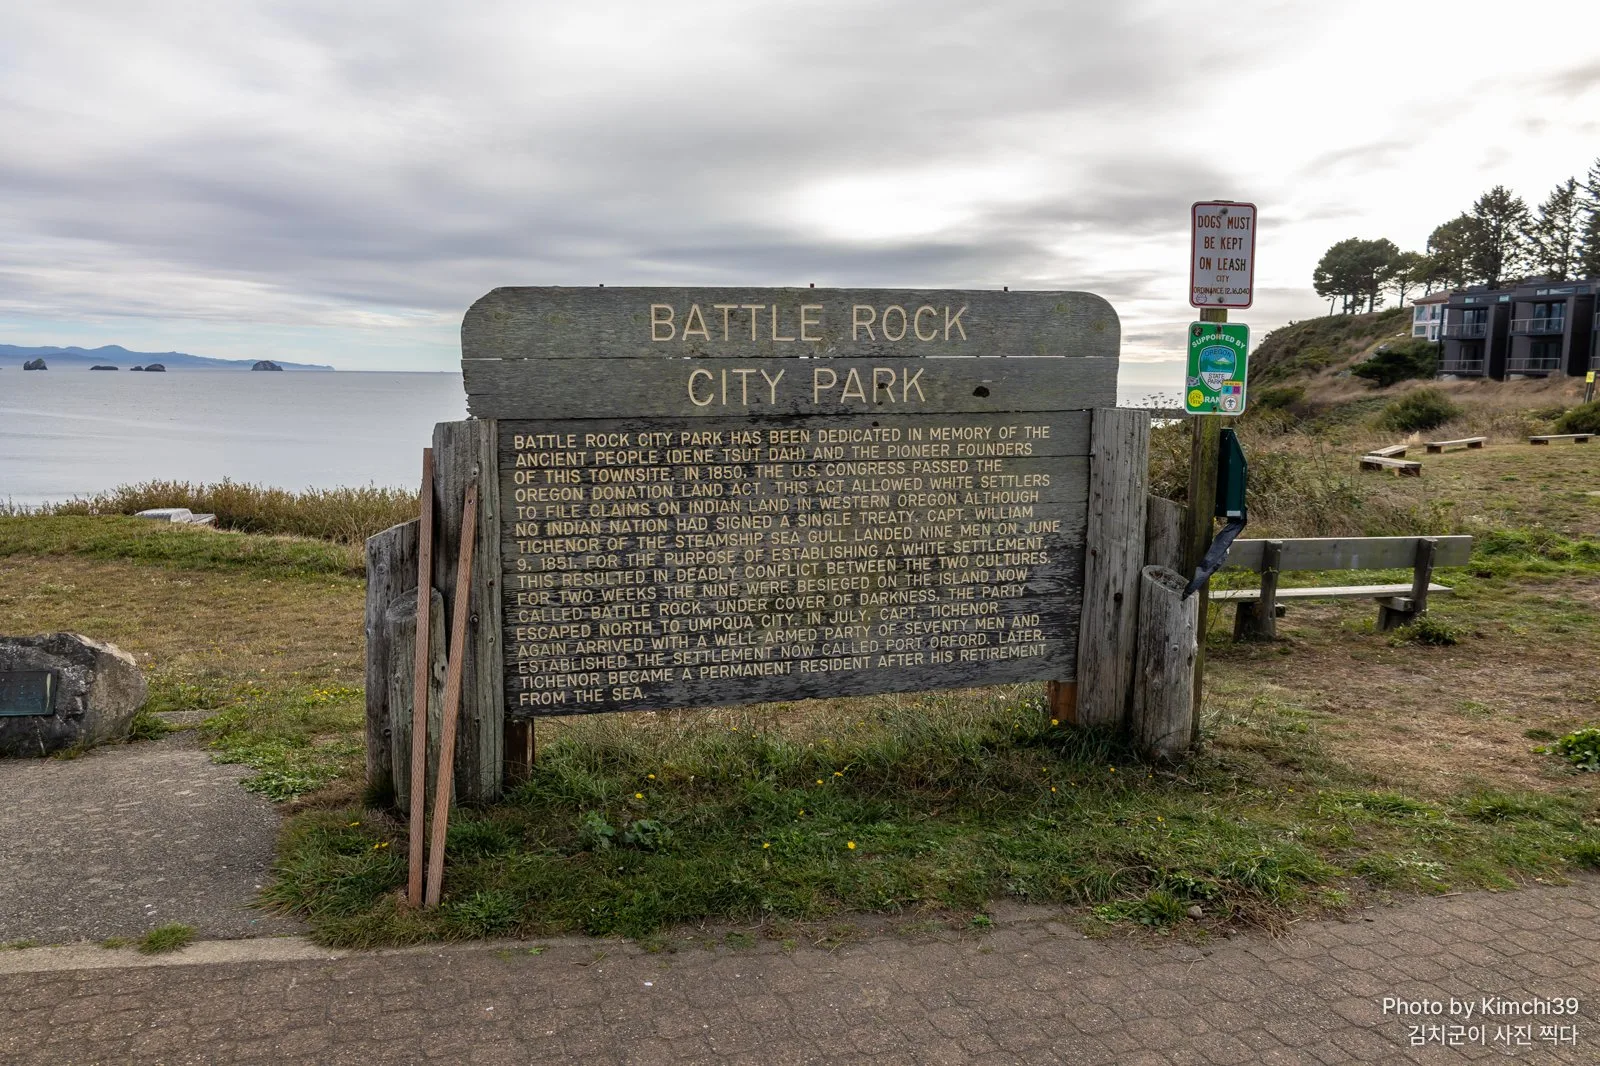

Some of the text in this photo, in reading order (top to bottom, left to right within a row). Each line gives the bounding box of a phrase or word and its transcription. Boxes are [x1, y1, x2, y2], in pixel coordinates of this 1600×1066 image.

[1198, 215, 1250, 230] DOGS MUST
[1204, 236, 1243, 250] BE KEPT
[1199, 257, 1246, 271] ON LEASH
[1194, 286, 1224, 294] ORDINANCE
[650, 303, 968, 343] BATTLE ROCK
[1192, 333, 1246, 349] SUPPORTED BY
[1205, 348, 1231, 357] OREGON
[687, 366, 926, 406] CITY PARK
[515, 426, 1050, 449] BATTLE ROCK CITY PARK HAS BEEN DEDICATED IN MEMORY OF THE
[516, 443, 1032, 467] ANCIENT PEOPLE (DENE TSUT DAH) AND THE PIONEER FOUNDERS
[515, 460, 1002, 484] OF THIS TOWNSITE. IN 1850, THE U.S. CONGRESS PASSED THE
[515, 474, 1050, 502] OREGON DONATION LAND ACT. THIS ACT ALLOWED WHITE SETTLERS
[516, 491, 1039, 520] TO FILE CLAIMS ON INDIAN LAND IN WESTERN OREGON ALTHOUGH
[516, 523, 538, 536] NO
[548, 521, 601, 535] INDIAN
[610, 519, 667, 533] NATION
[676, 518, 708, 531] HAD
[716, 516, 772, 530] SIGNED
[780, 515, 790, 527] A
[798, 512, 851, 527] SINGLE
[928, 509, 967, 522] CAPT.
[975, 506, 1033, 520] WILLIAM
[517, 520, 1061, 554] TICHENOR OF THE STEAMSHIP SEA GULL LANDED NINE MEN ON JUNE
[518, 553, 1051, 588] THIS RESULTED IN DEADLY CONFLICT BETWEEN THE TWO CULTURES.
[518, 569, 1027, 606] FOR TWO WEEKS THE NINE WERE BESIEGED ON THE ISLAND NOW
[518, 608, 582, 623] CALLED
[591, 605, 650, 619] BATTLE
[660, 602, 706, 616] ROCK.
[716, 599, 768, 613] UNDER
[775, 595, 824, 610] COVER
[833, 594, 851, 606] OF
[949, 588, 975, 600] THE
[983, 584, 1025, 597] PARTY
[518, 643, 566, 657] AGAIN
[576, 639, 643, 654] ARRIVED
[652, 637, 688, 650] WITH
[697, 635, 707, 647] A
[825, 626, 871, 640] PARTY
[878, 624, 897, 636] OF
[905, 619, 969, 635] SEVENTY
[975, 617, 1005, 630] MEN
[1012, 615, 1039, 627] AND
[519, 630, 1046, 673] ESTABLISHED THE SETTLEMENT NOW CALLED PORT ORFORD. LATER,
[520, 644, 1046, 689] TICHENOR BECAME A PERMANENT RESIDENT AFTER HIS RETIREMENT
